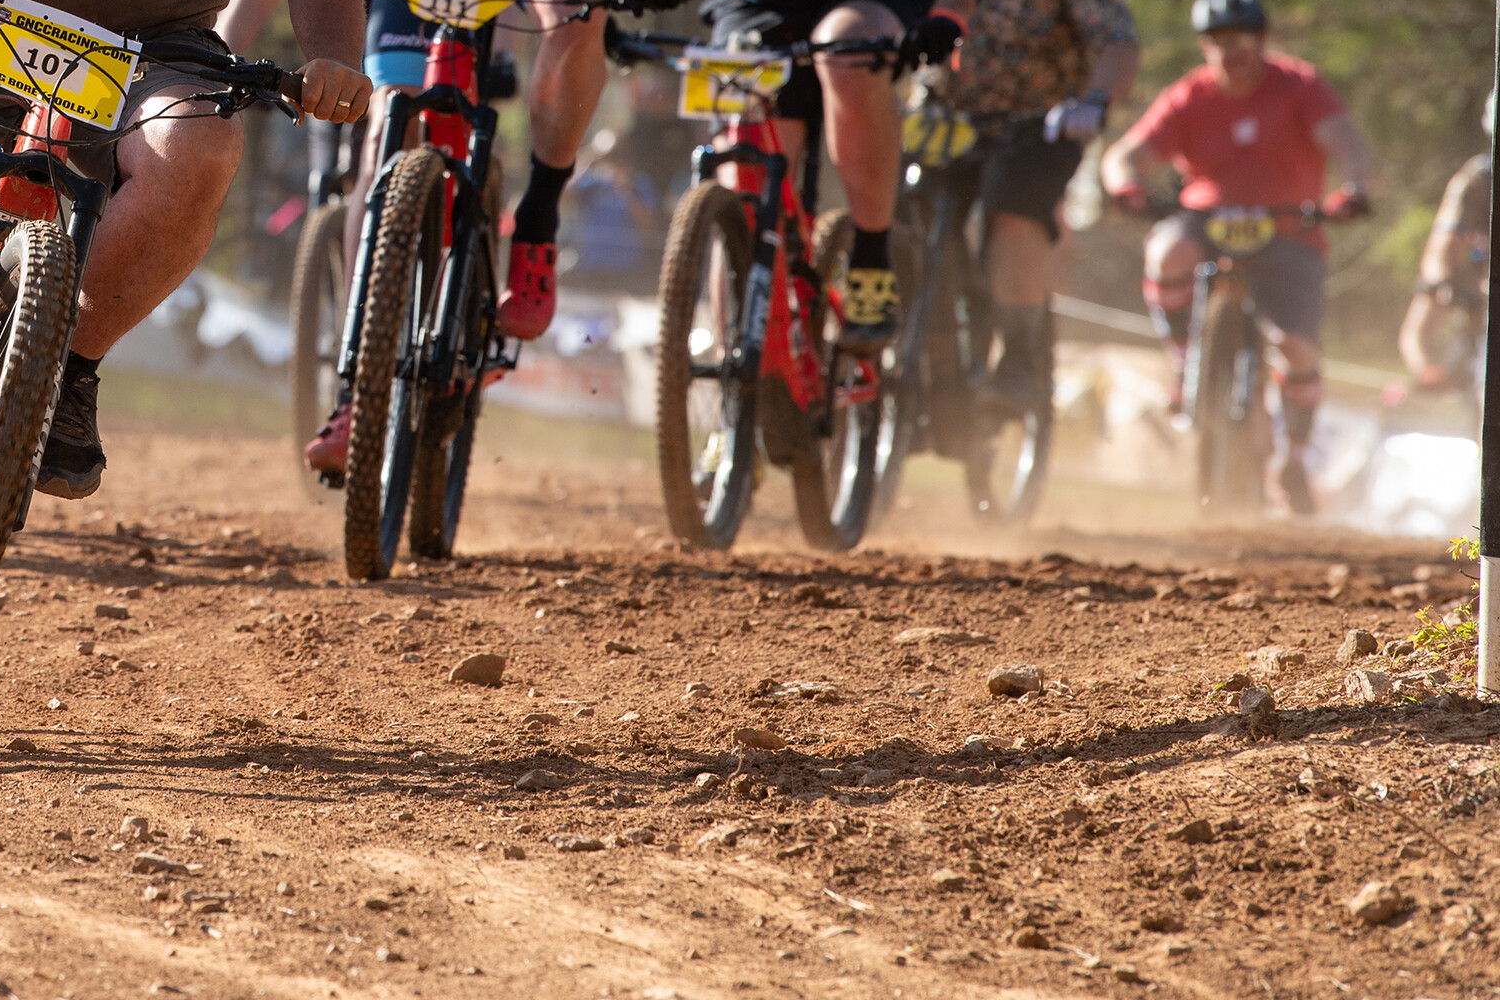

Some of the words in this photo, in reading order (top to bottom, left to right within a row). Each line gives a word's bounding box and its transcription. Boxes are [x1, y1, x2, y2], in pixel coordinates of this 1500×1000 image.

[16, 15, 133, 64] GNCCRACING.COM
[24, 47, 80, 80] 107
[8, 77, 38, 96] BORE
